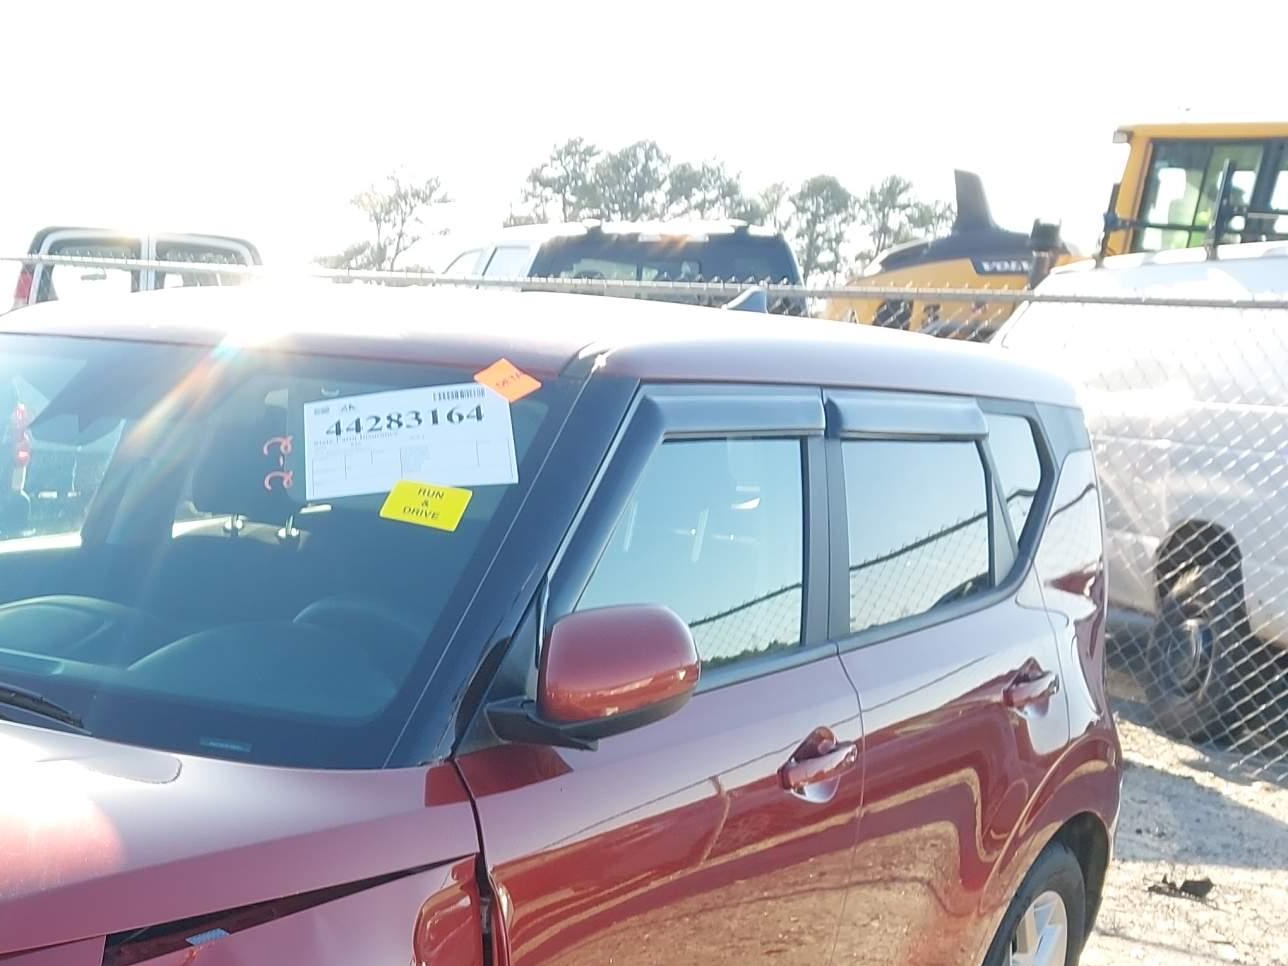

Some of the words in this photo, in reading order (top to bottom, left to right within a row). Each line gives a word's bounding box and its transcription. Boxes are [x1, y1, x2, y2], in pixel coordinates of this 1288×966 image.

[981, 260, 1032, 272] VOLV
[325, 404, 485, 436] 44283164
[417, 487, 445, 499] RUN
[402, 505, 440, 520] DRIVE
